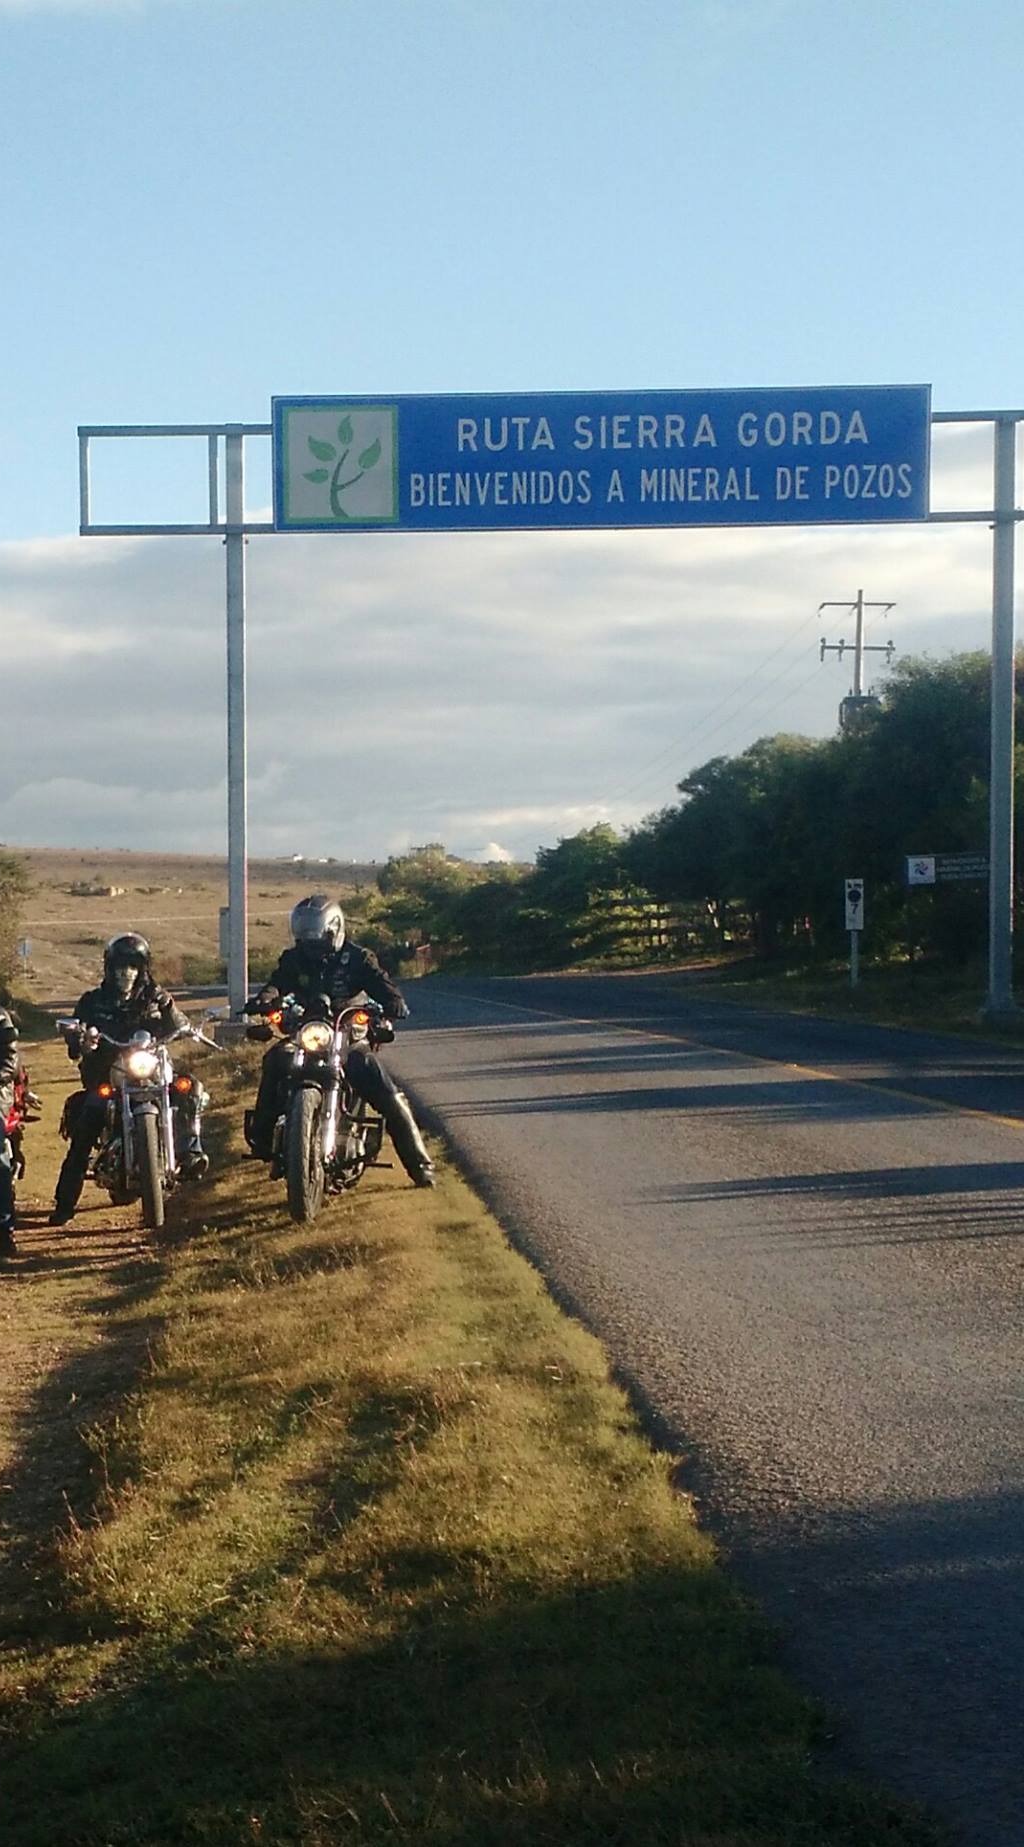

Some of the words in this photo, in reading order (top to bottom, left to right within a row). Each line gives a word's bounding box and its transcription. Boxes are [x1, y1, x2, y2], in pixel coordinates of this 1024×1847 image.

[457, 416, 556, 452] RUTA
[573, 413, 718, 450] SIERRA
[737, 410, 869, 447] GORDA
[409, 469, 592, 507] BIENVENIDOS
[606, 468, 625, 503] A
[640, 466, 760, 502] MINERAL
[775, 465, 810, 501] DE
[825, 463, 913, 499] POZOS
[850, 903, 859, 914] 7
